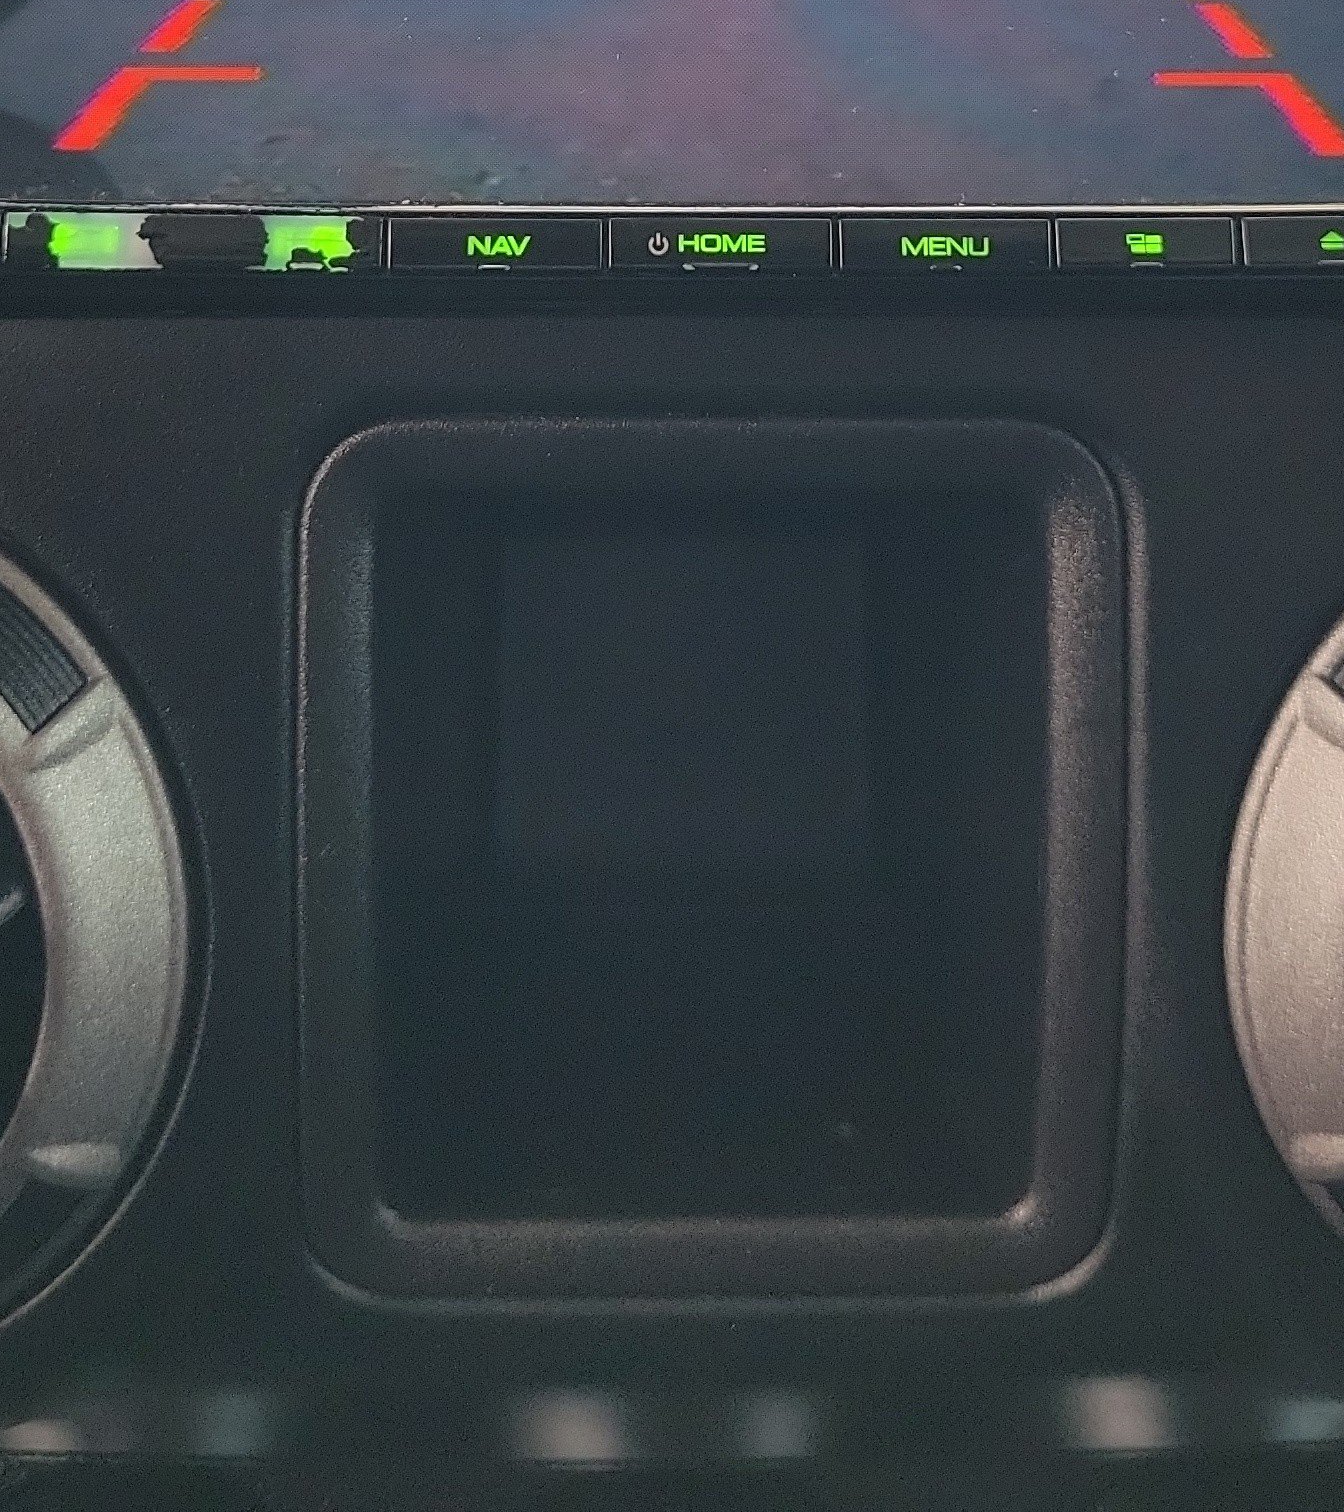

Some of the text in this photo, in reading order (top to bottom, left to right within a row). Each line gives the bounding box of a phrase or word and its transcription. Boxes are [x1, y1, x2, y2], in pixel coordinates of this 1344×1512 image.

[466, 234, 532, 258] NAV
[676, 231, 768, 256] HOME
[899, 234, 991, 260] MENU
